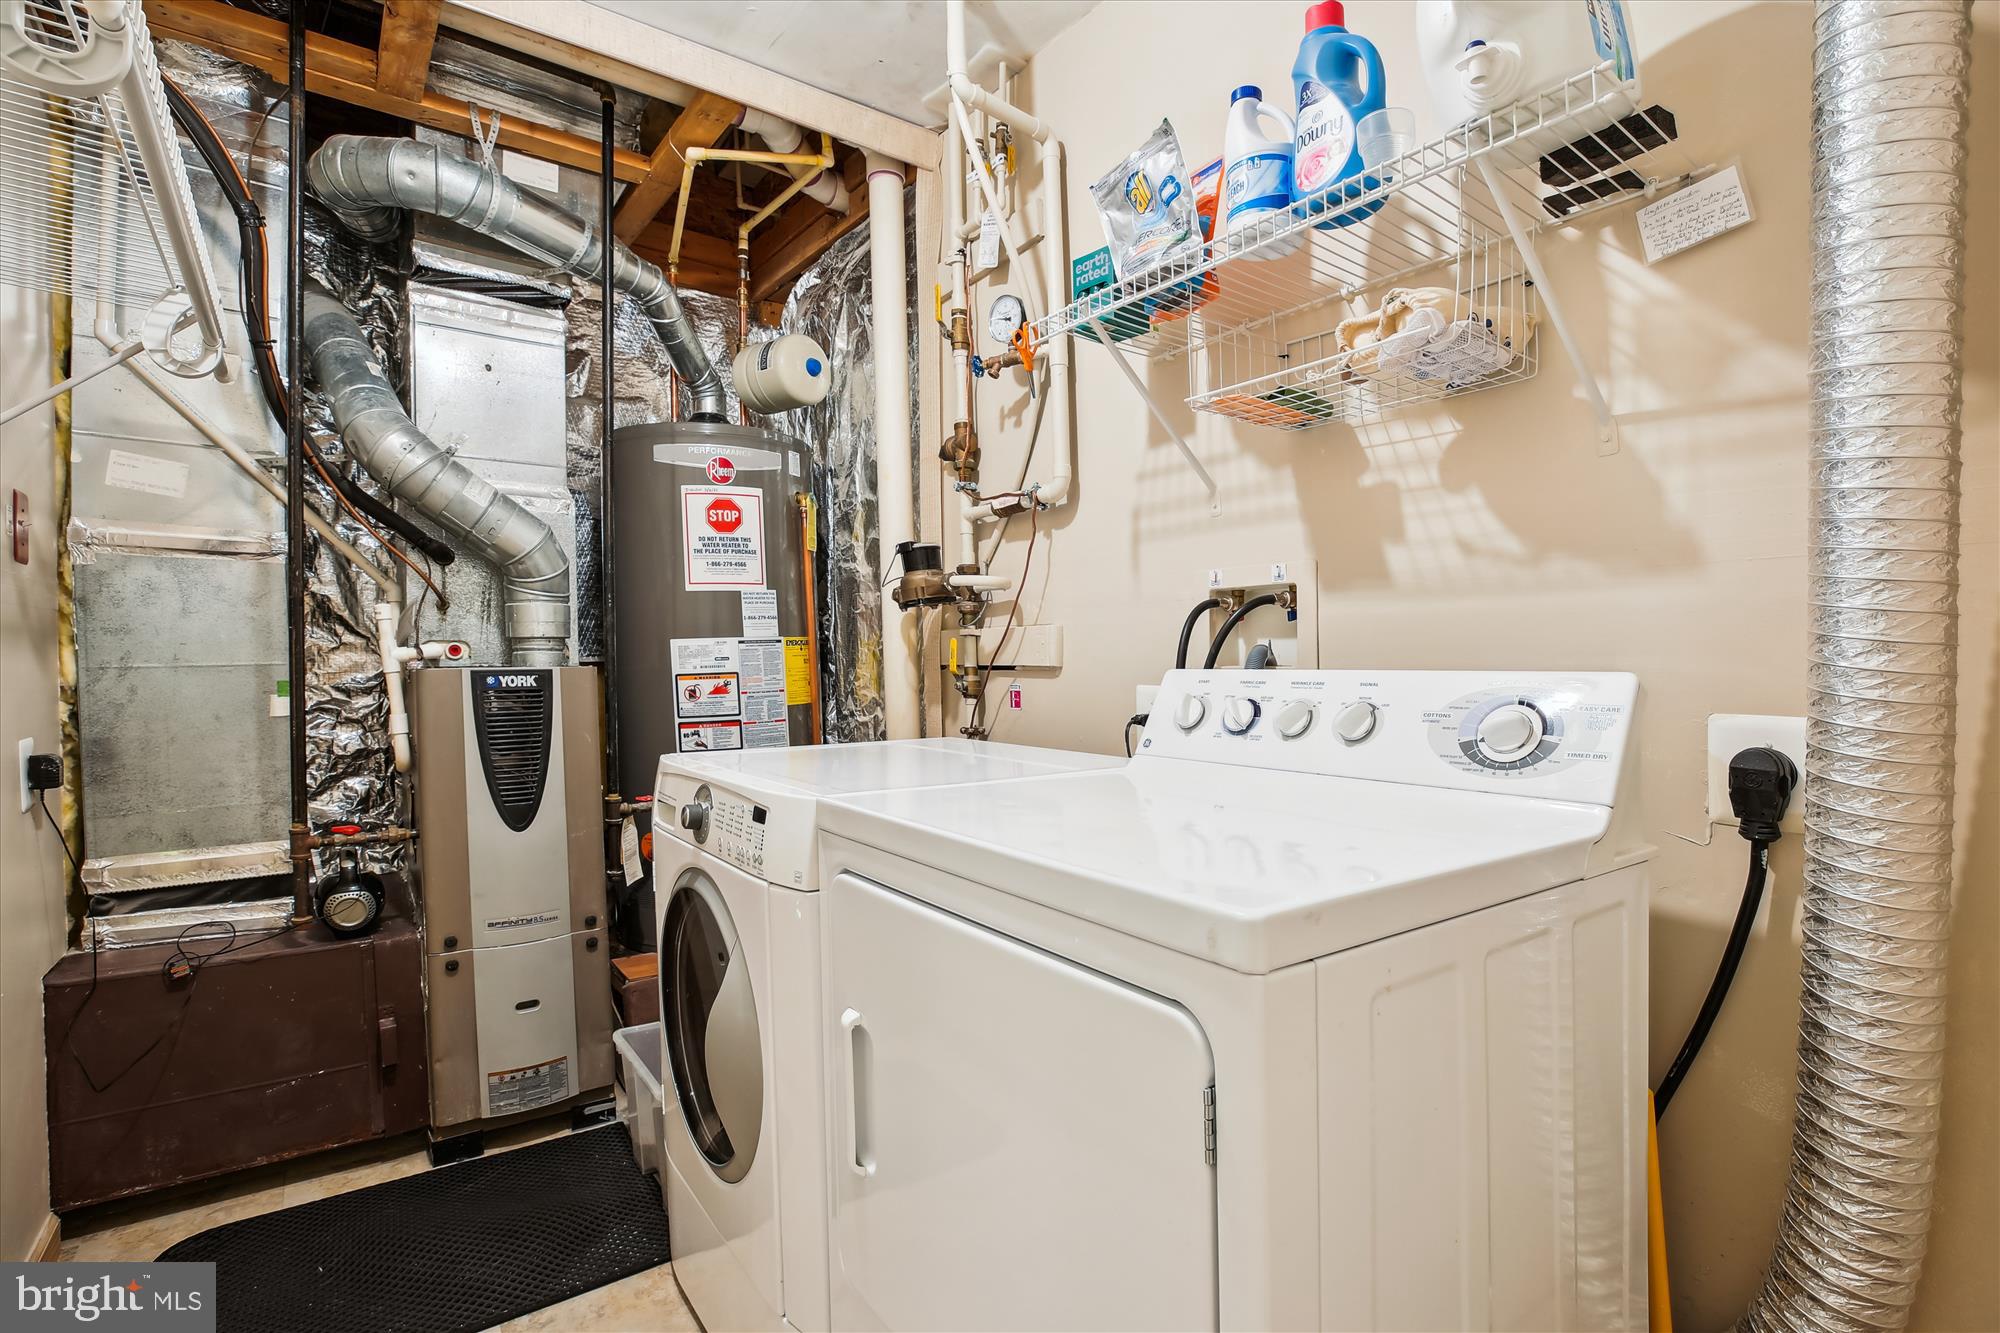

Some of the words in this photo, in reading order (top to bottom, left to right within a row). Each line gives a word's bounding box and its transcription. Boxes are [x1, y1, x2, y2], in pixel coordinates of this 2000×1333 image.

[1296, 114, 1344, 154] Downy
[1131, 169, 1153, 214] all
[1075, 249, 1110, 274] earth
[1076, 265, 1109, 286] rated
[688, 446, 751, 457] PERFORMANCE
[709, 457, 735, 480] Rheem
[709, 509, 739, 522] STOP
[498, 675, 537, 687] YORK
